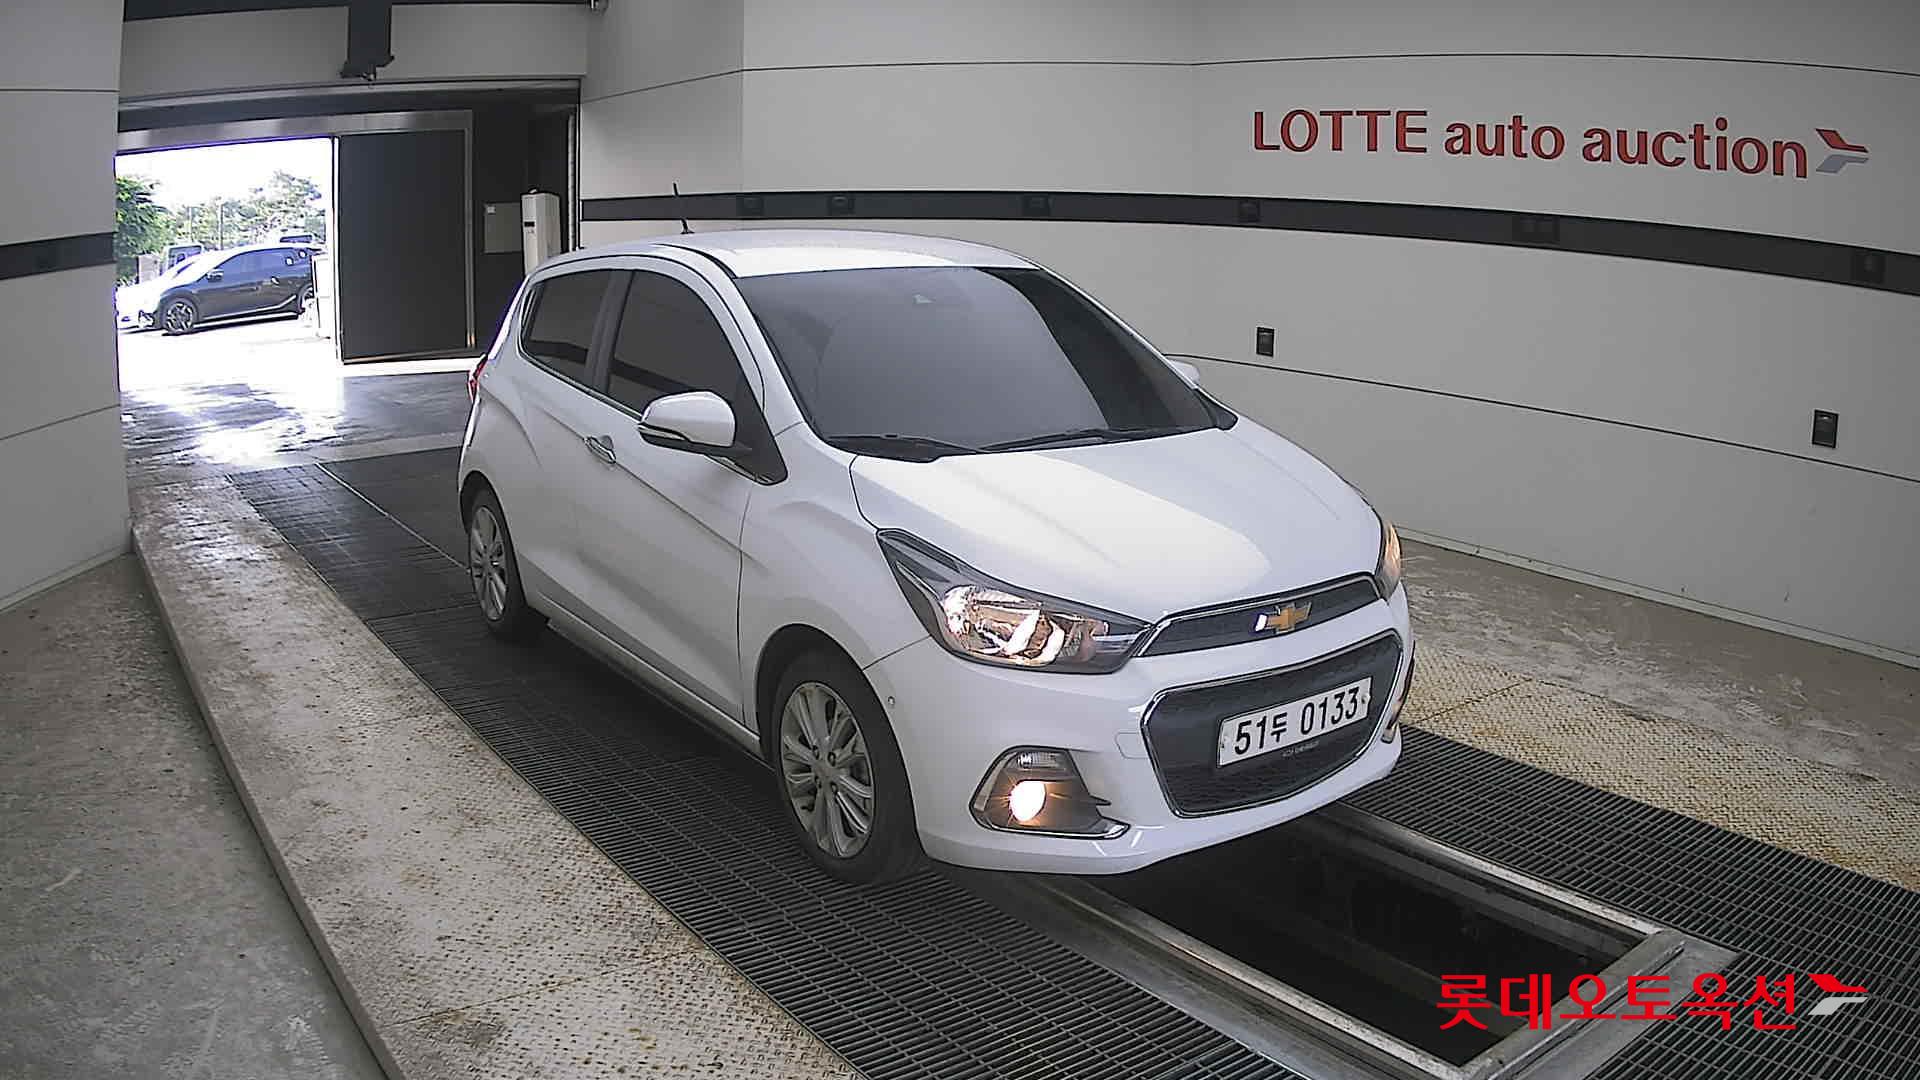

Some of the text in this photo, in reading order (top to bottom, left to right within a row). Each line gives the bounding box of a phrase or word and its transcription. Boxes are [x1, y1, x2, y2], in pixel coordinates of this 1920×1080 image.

[1253, 109, 1808, 178] LOTTE auto auction
[1234, 686, 1360, 755] 51두 0133
